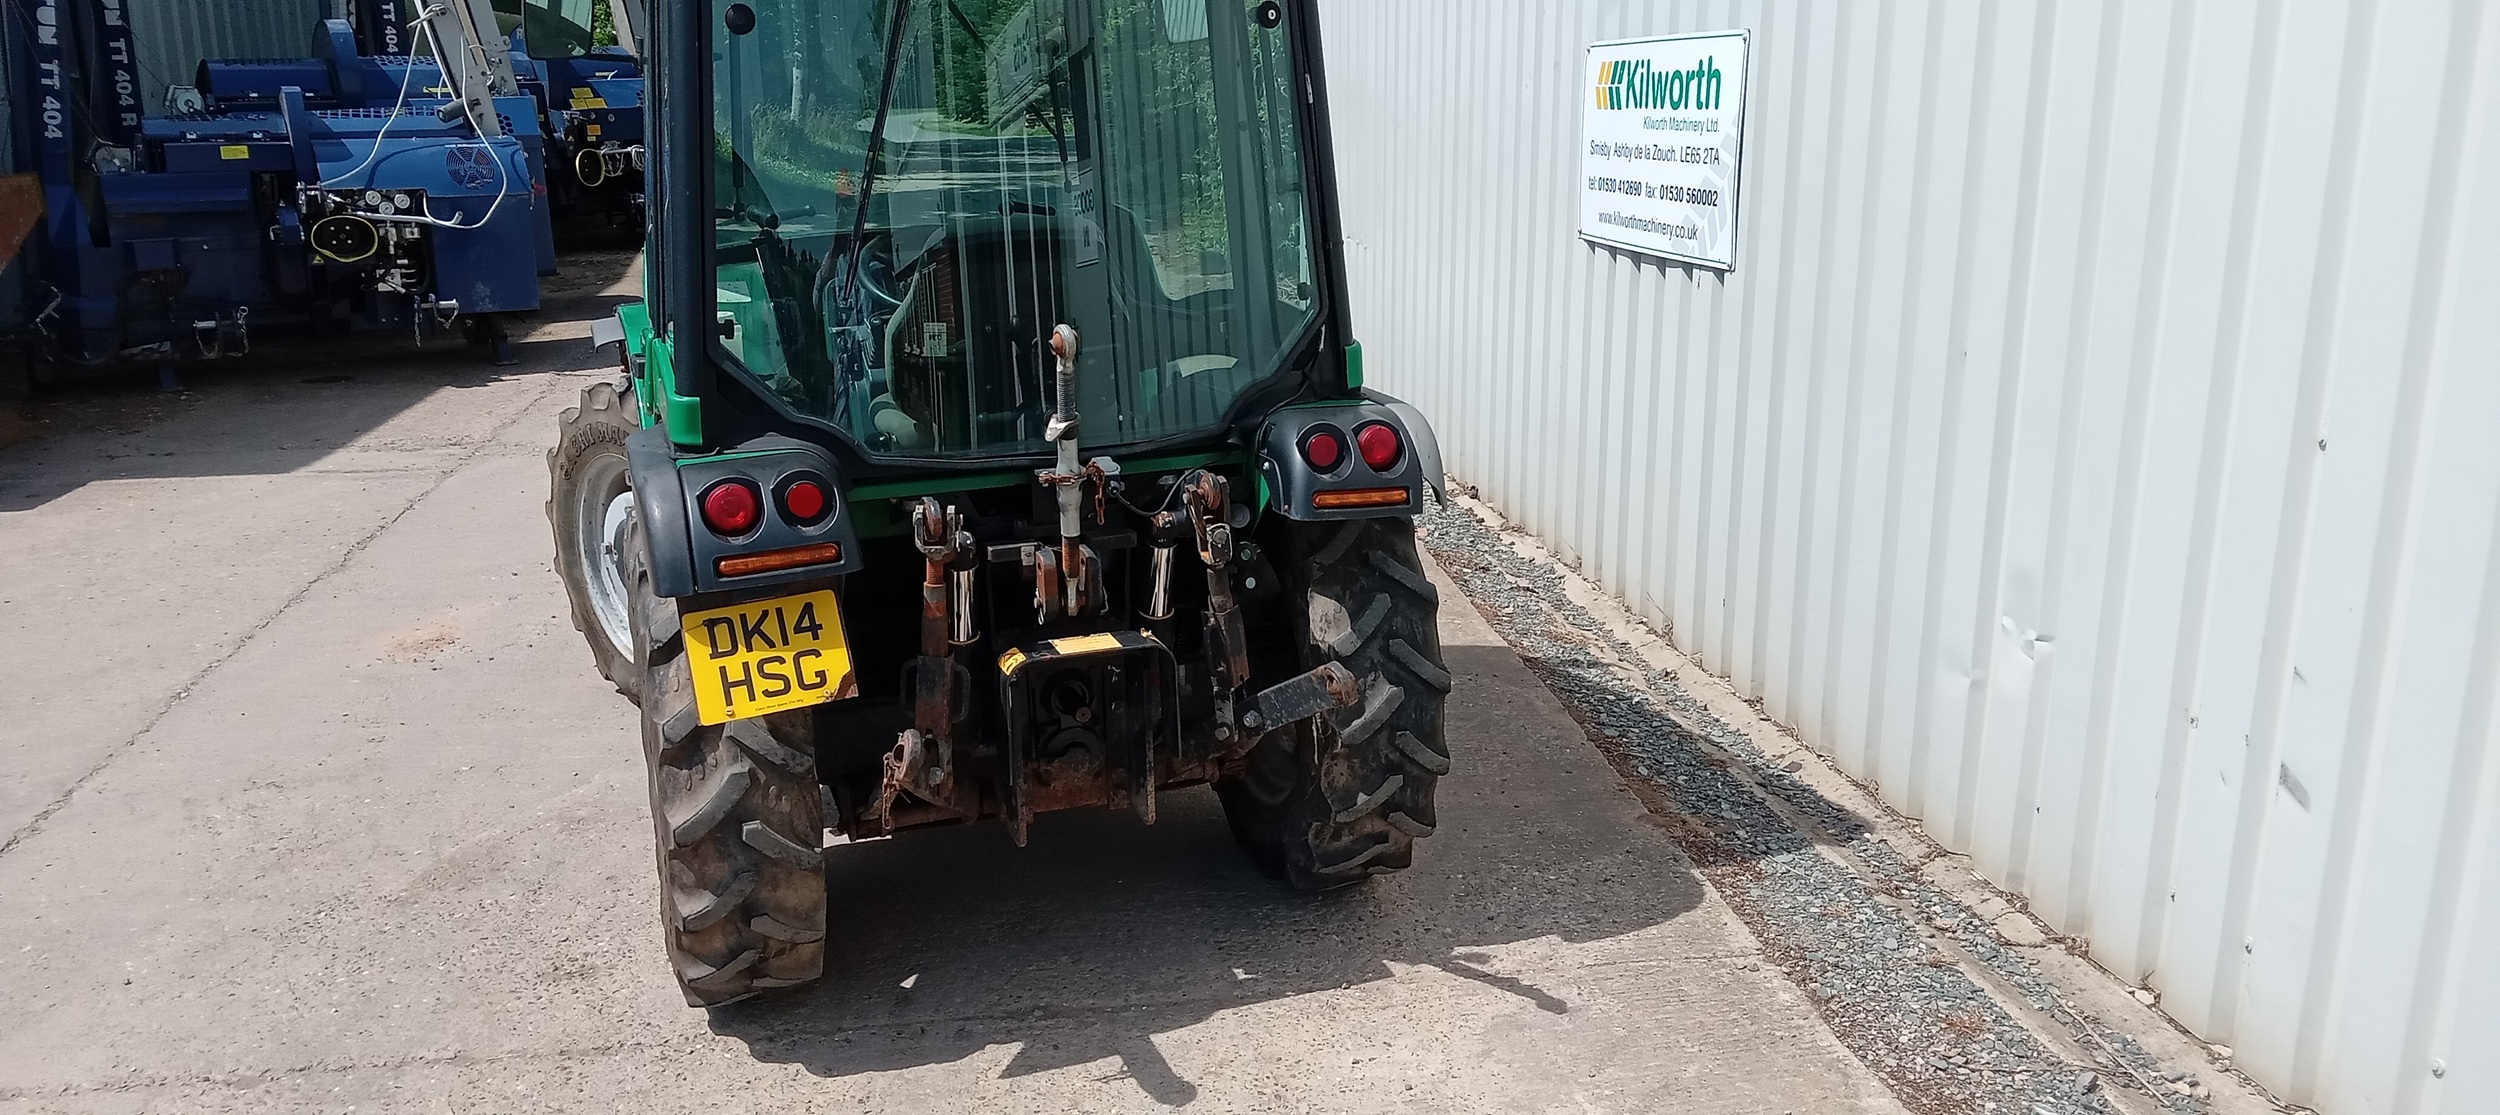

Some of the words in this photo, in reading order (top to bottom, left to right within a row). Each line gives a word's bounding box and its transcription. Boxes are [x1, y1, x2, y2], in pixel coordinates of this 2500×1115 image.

[381, 1, 396, 22] TT
[109, 37, 128, 64] TT
[384, 25, 399, 53] 404
[40, 59, 60, 90] TT
[114, 69, 135, 107] 404
[1625, 55, 1721, 110] Kilworth
[42, 95, 63, 139] 404
[120, 112, 138, 126] R
[1643, 116, 1667, 130] Kilworth
[1668, 117, 1705, 136] Machinery
[1706, 117, 1720, 132] Ltd.
[1589, 139, 1612, 161] Smisby
[1613, 141, 1633, 162] Ashby
[1634, 144, 1643, 160] de
[1644, 144, 1651, 160] la
[1651, 144, 1678, 162] Zouch.
[1680, 146, 1701, 164] LE65
[1702, 147, 1720, 165] 2TA
[1598, 176, 1617, 194] 01530
[1617, 178, 1642, 197] 412690
[1645, 181, 1658, 199] fax:
[1659, 184, 1684, 203] 01530
[1686, 187, 1718, 207] 560002
[1598, 211, 1698, 241] www.kilworthmachinery.co.uk
[703, 601, 824, 660] DK14
[718, 648, 828, 707] HSG
